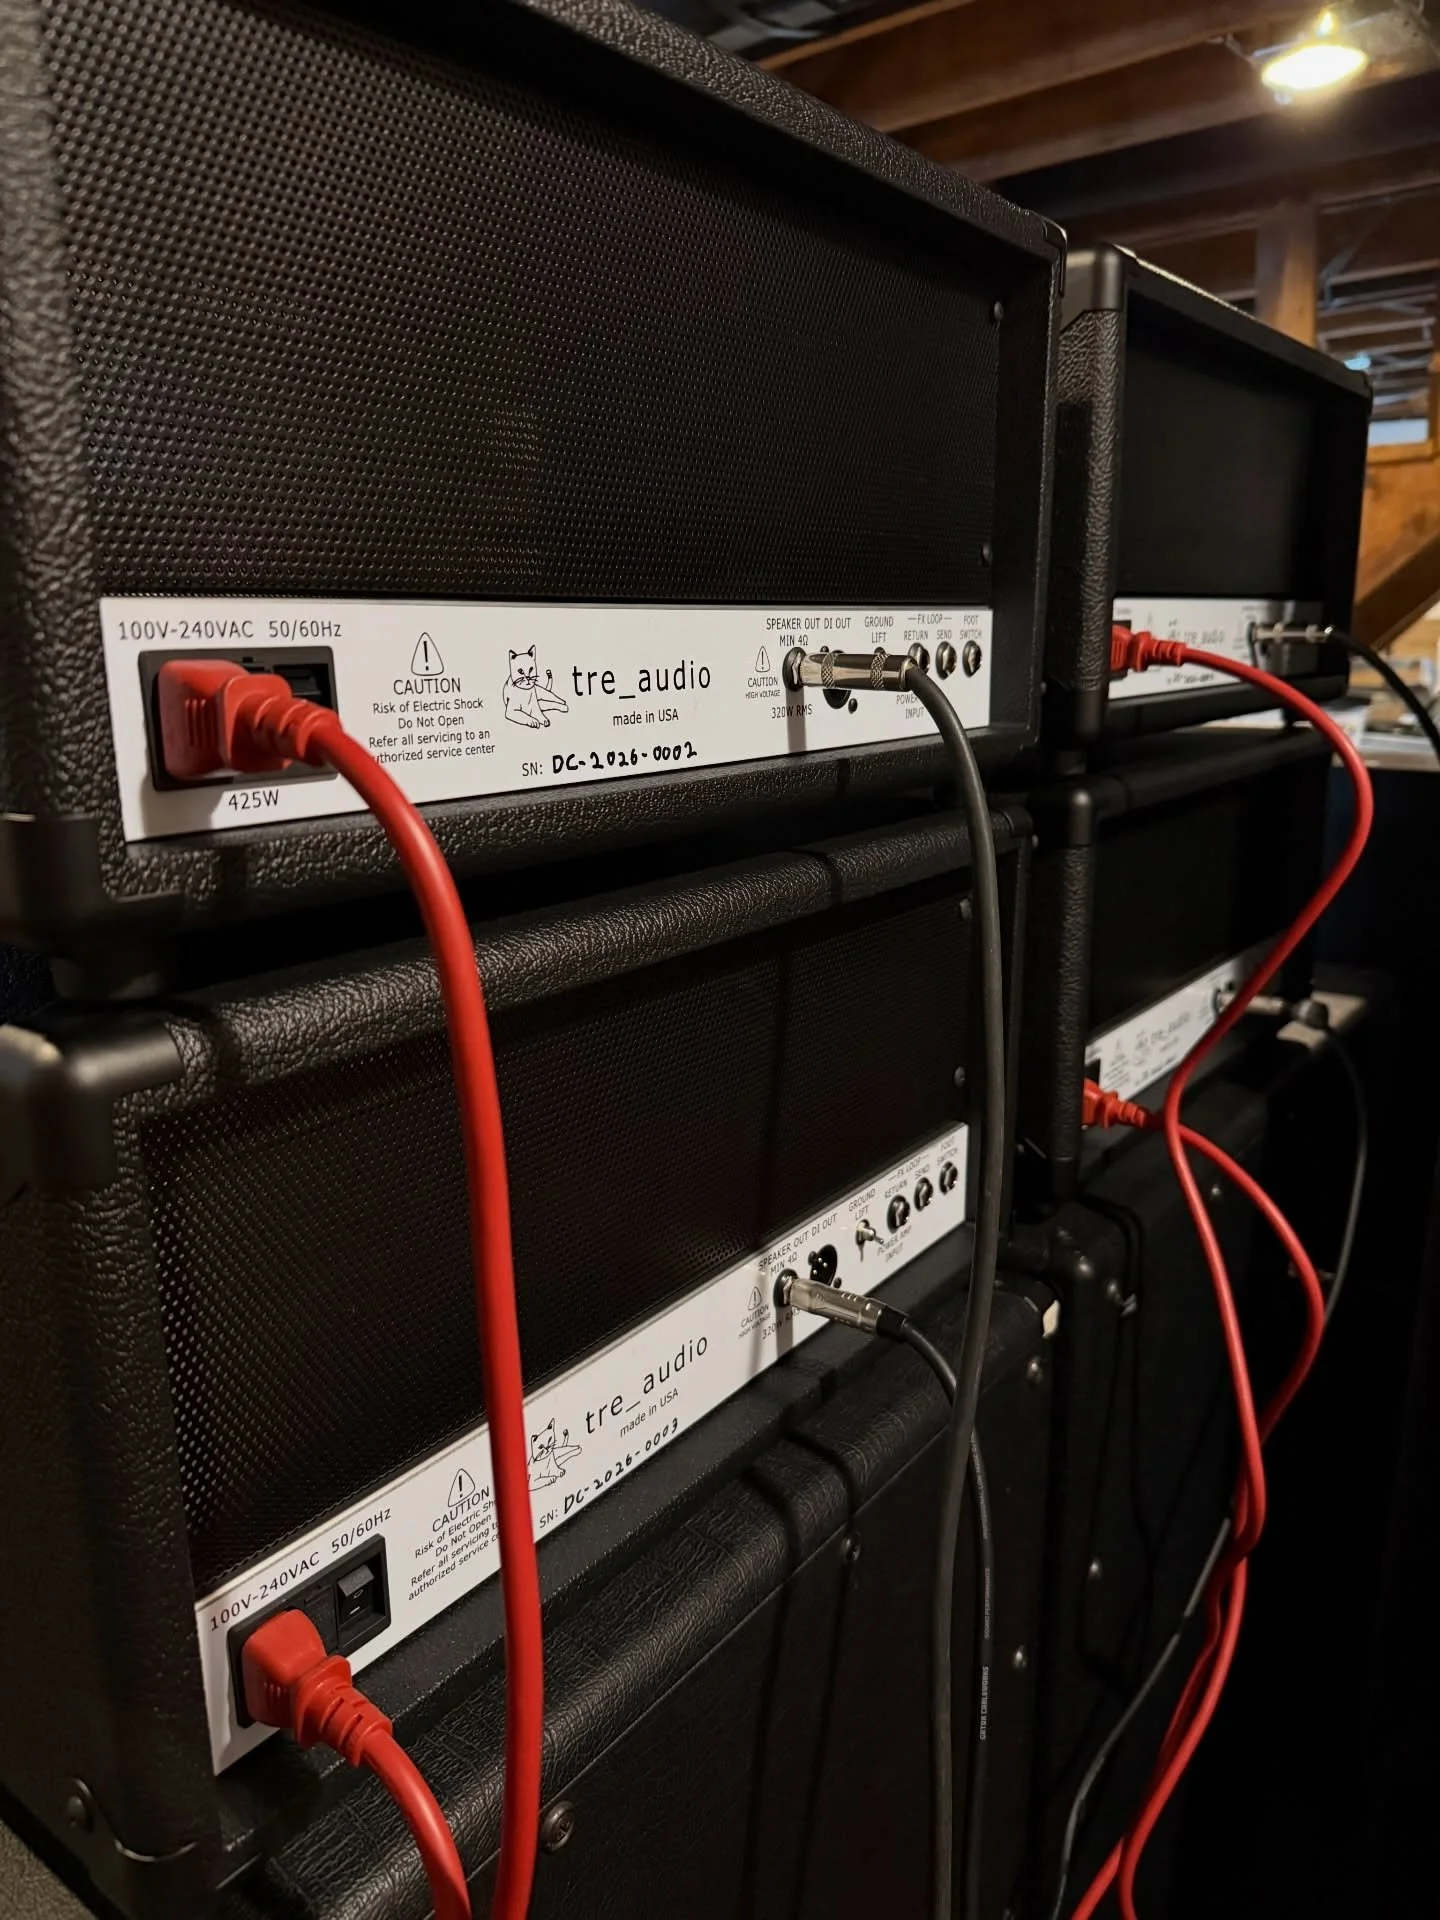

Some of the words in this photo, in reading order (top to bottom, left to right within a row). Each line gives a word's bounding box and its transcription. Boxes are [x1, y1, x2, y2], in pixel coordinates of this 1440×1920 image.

[766, 617, 802, 631] SPEAKER
[804, 617, 821, 630] OUT
[823, 617, 833, 630] DI
[835, 616, 852, 630] OUT
[864, 615, 894, 628] GROUND
[917, 613, 926, 625] FX
[926, 613, 943, 625] LOOP
[963, 614, 979, 626] FOOT
[118, 619, 255, 641] 100V-240VAC
[268, 620, 343, 640] 50/60Hz
[779, 634, 796, 647] MIN
[797, 633, 809, 646] 4Ω
[871, 631, 887, 644] LIFT
[903, 630, 929, 641] RETURN
[936, 629, 953, 640] SEND
[960, 629, 982, 640] SWITCH
[393, 677, 462, 696] CAUTION
[571, 659, 711, 700] tre_audio
[747, 676, 778, 688] CAUTION
[745, 691, 759, 699] HIGH
[759, 689, 781, 698] VOLTAGE
[373, 701, 397, 714] Risk
[399, 700, 411, 713] of
[413, 699, 451, 712] Electric
[454, 697, 484, 711] Shock
[771, 705, 794, 719] 320W
[796, 703, 813, 717] RMS
[905, 706, 925, 720] INPUT
[398, 716, 414, 730] Do
[416, 715, 435, 728] Not
[437, 714, 465, 730] Open
[612, 710, 642, 727] made
[645, 710, 655, 724] in
[658, 708, 680, 723] USA
[368, 735, 398, 749] Refer
[401, 733, 414, 746] all
[417, 730, 463, 748] servicing
[465, 730, 477, 742] to
[479, 729, 491, 740] an
[371, 748, 423, 765] thorized
[426, 745, 463, 760] service
[465, 743, 496, 757] center
[521, 761, 544, 777] SN:
[551, 740, 698, 774] DC-2026-0002
[228, 789, 280, 811] 425W
[848, 1188, 876, 1212] GROUND
[854, 1204, 870, 1222] LIFT
[811, 1223, 821, 1238] DI
[822, 1213, 838, 1230] OUT
[758, 1242, 792, 1272] SPEAKER
[794, 1230, 810, 1248] OUT
[770, 1262, 785, 1277] MIN
[787, 1251, 799, 1265] 4Ω
[740, 1303, 769, 1328] CAUTION
[762, 1319, 783, 1340] 320W
[585, 1336, 708, 1435] tre_audio
[619, 1412, 646, 1438] made
[648, 1404, 657, 1416] in
[660, 1387, 679, 1408] USA
[539, 1508, 558, 1529] SN:
[563, 1416, 679, 1516] DC-2026-0003
[432, 1485, 490, 1533] CAUTION
[415, 1541, 434, 1559] Risk
[437, 1532, 446, 1544] of
[448, 1509, 481, 1537] Electric
[435, 1544, 448, 1558] Do
[451, 1531, 466, 1546] Not
[469, 1514, 492, 1535] Open
[411, 1564, 436, 1588] Refer
[437, 1553, 449, 1568] all
[451, 1526, 490, 1560] servicing
[210, 1551, 321, 1632] 100V-240VAC
[331, 1507, 392, 1554] 50/60Hz
[408, 1560, 456, 1601] authorized
[458, 1538, 489, 1565] service
